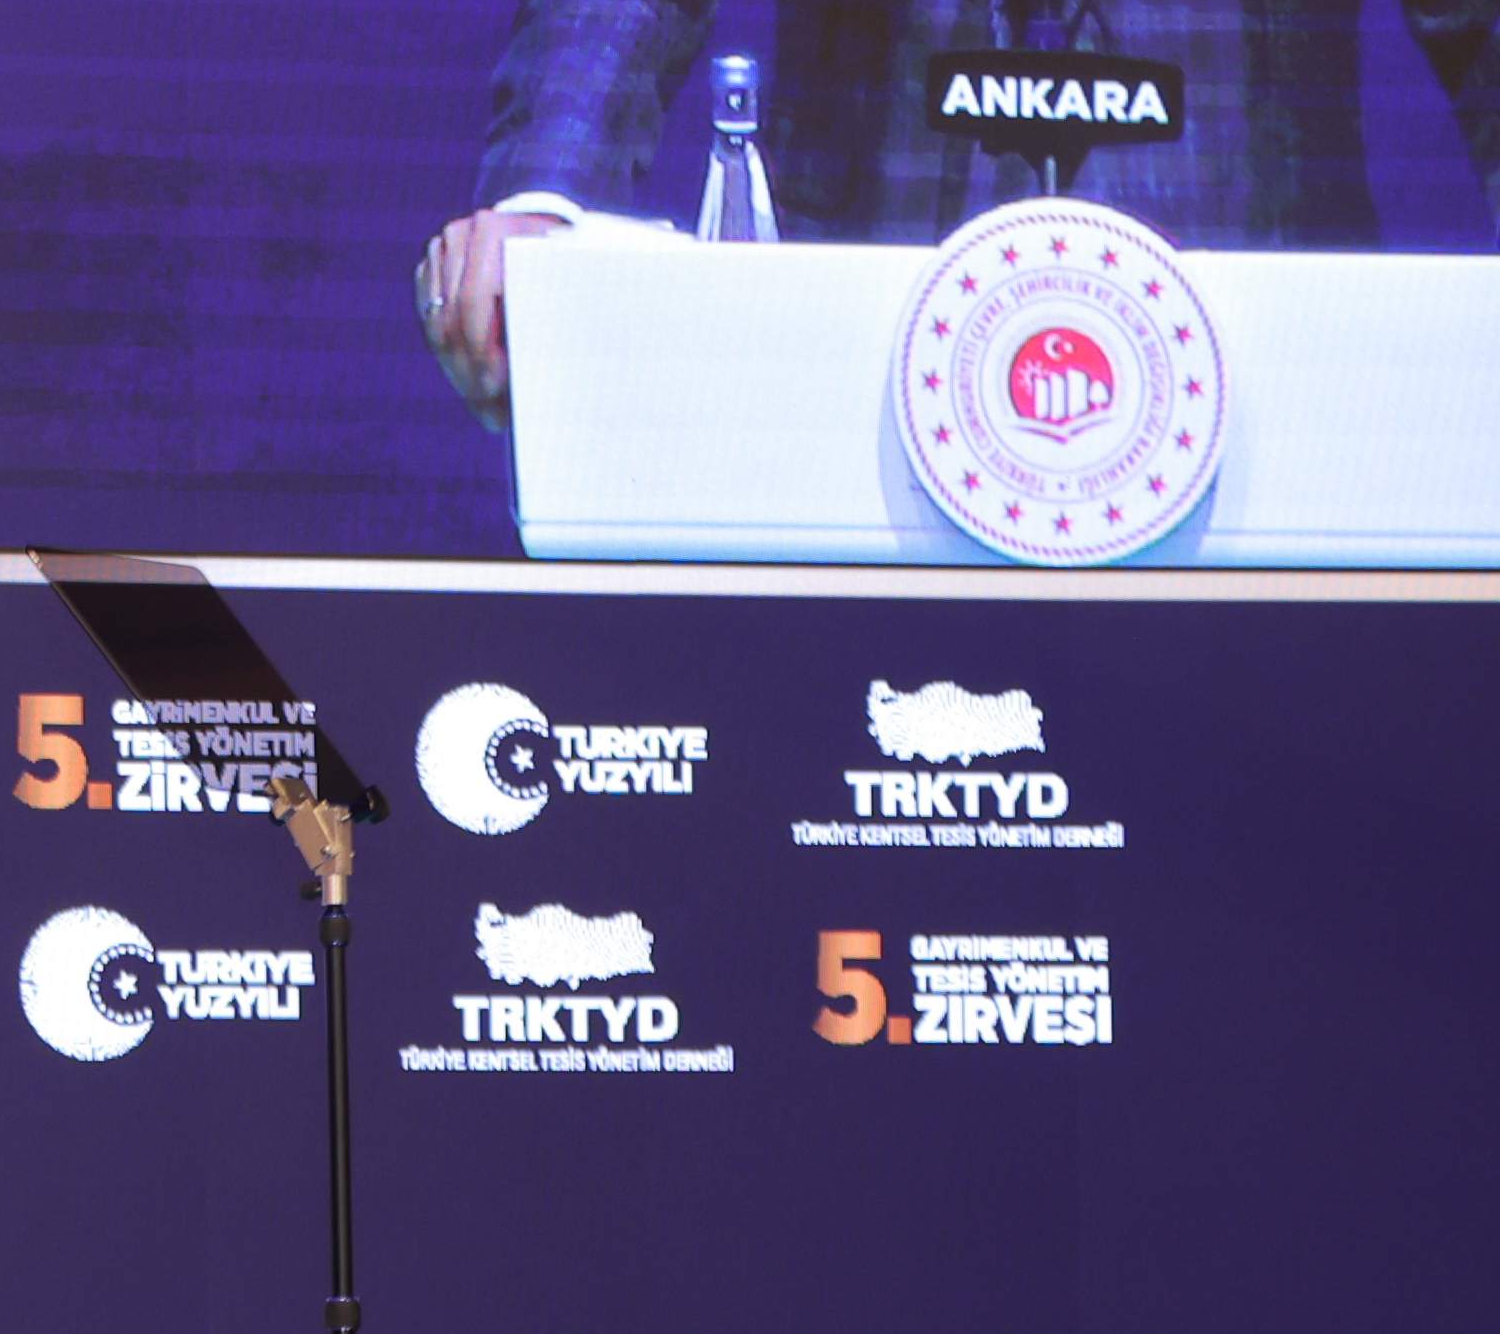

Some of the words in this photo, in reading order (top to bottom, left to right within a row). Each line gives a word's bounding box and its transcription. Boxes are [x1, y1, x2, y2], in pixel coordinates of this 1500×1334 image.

[940, 72, 1169, 124] ANKARA
[283, 701, 316, 725] VE
[14, 693, 112, 809] 5.
[846, 773, 1069, 819] TRKTYD
[1076, 938, 1109, 962] VE
[814, 929, 912, 1044] 5.
[455, 997, 679, 1043] TRKTYD
